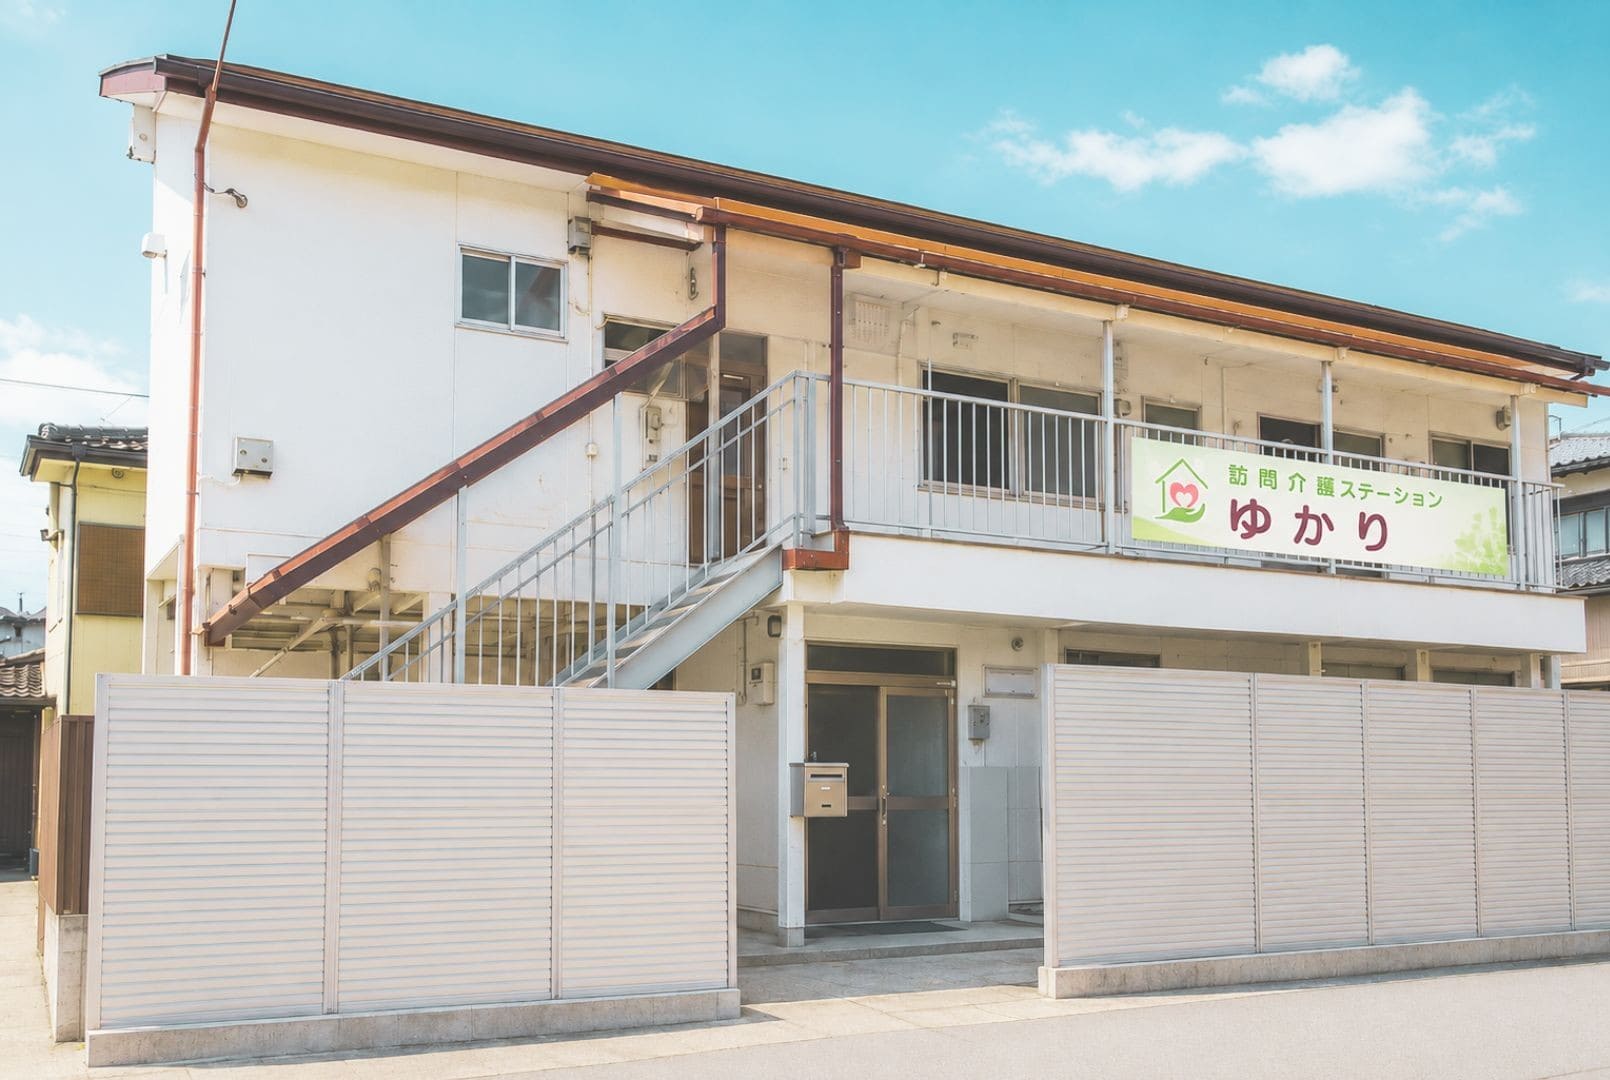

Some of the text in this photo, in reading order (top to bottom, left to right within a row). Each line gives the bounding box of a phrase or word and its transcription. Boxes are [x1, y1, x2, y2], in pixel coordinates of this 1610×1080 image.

[1229, 464, 1443, 508] 訪問介護ステーション
[1230, 498, 1388, 552] ゆかり
